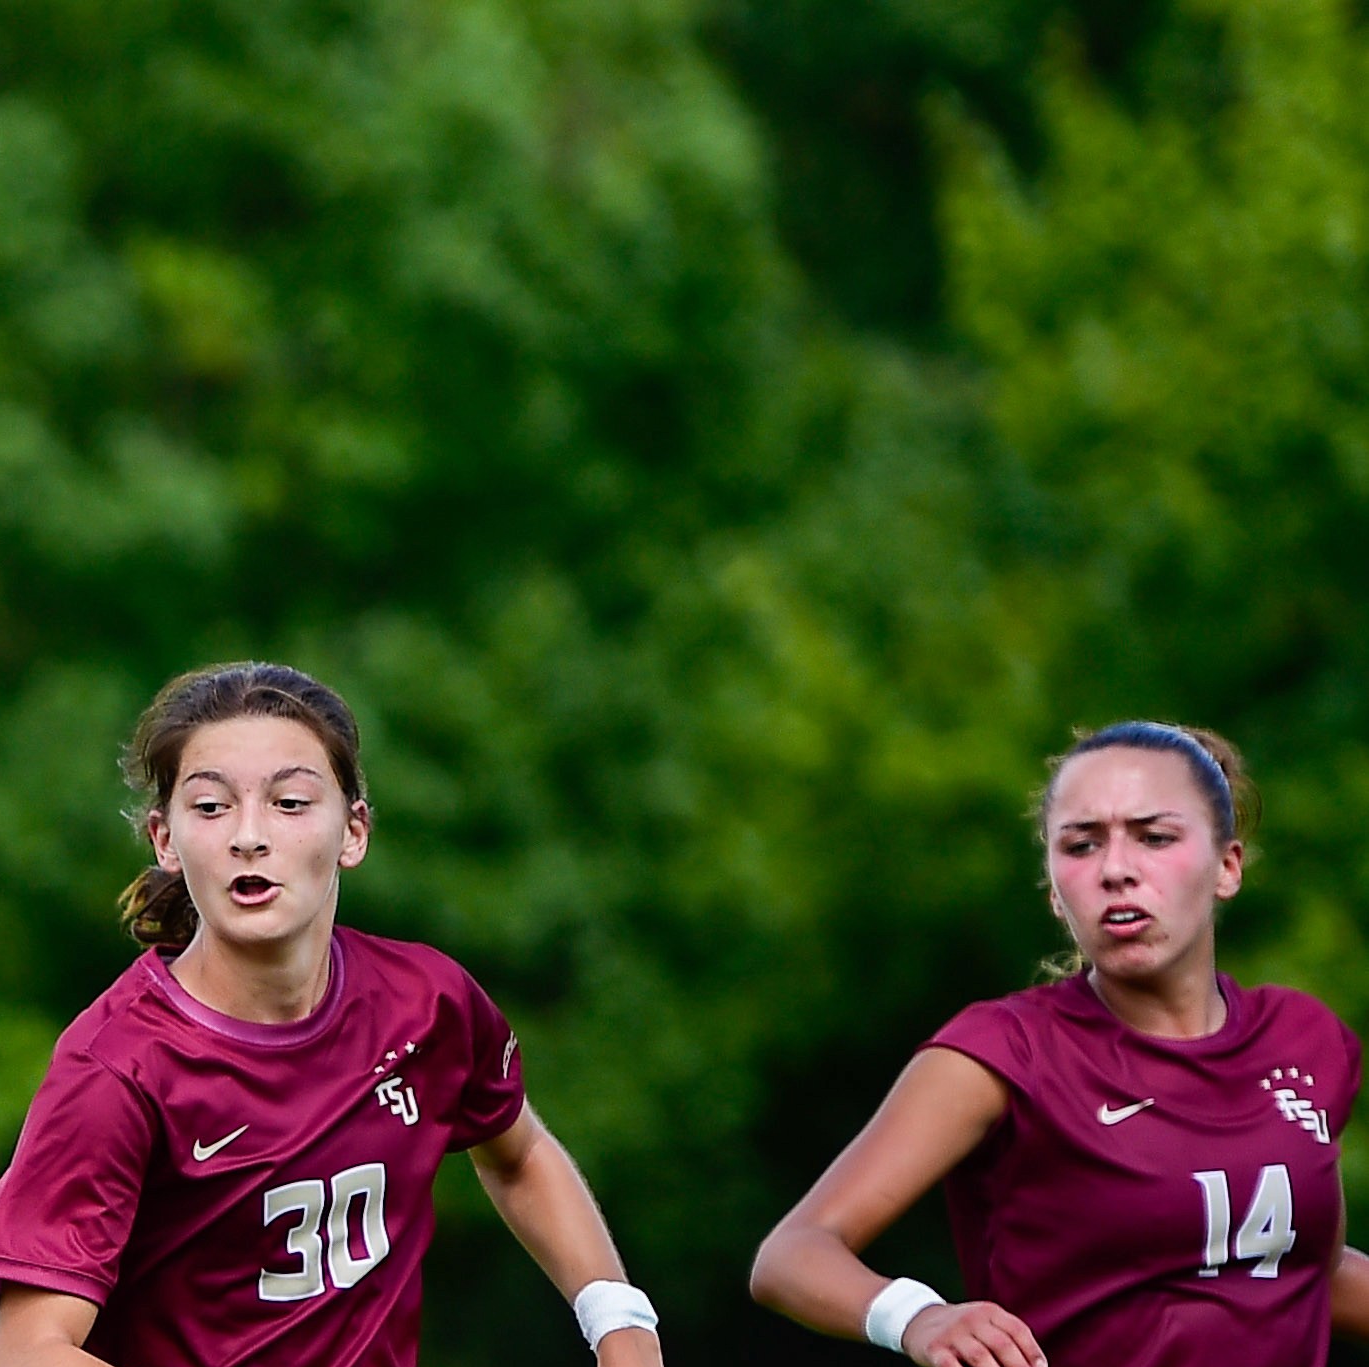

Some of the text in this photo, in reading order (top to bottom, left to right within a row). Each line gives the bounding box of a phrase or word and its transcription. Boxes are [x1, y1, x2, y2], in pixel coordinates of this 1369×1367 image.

[1274, 1088, 1331, 1144] FSU
[258, 1162, 390, 1302] 30
[1192, 1163, 1296, 1278] 14
